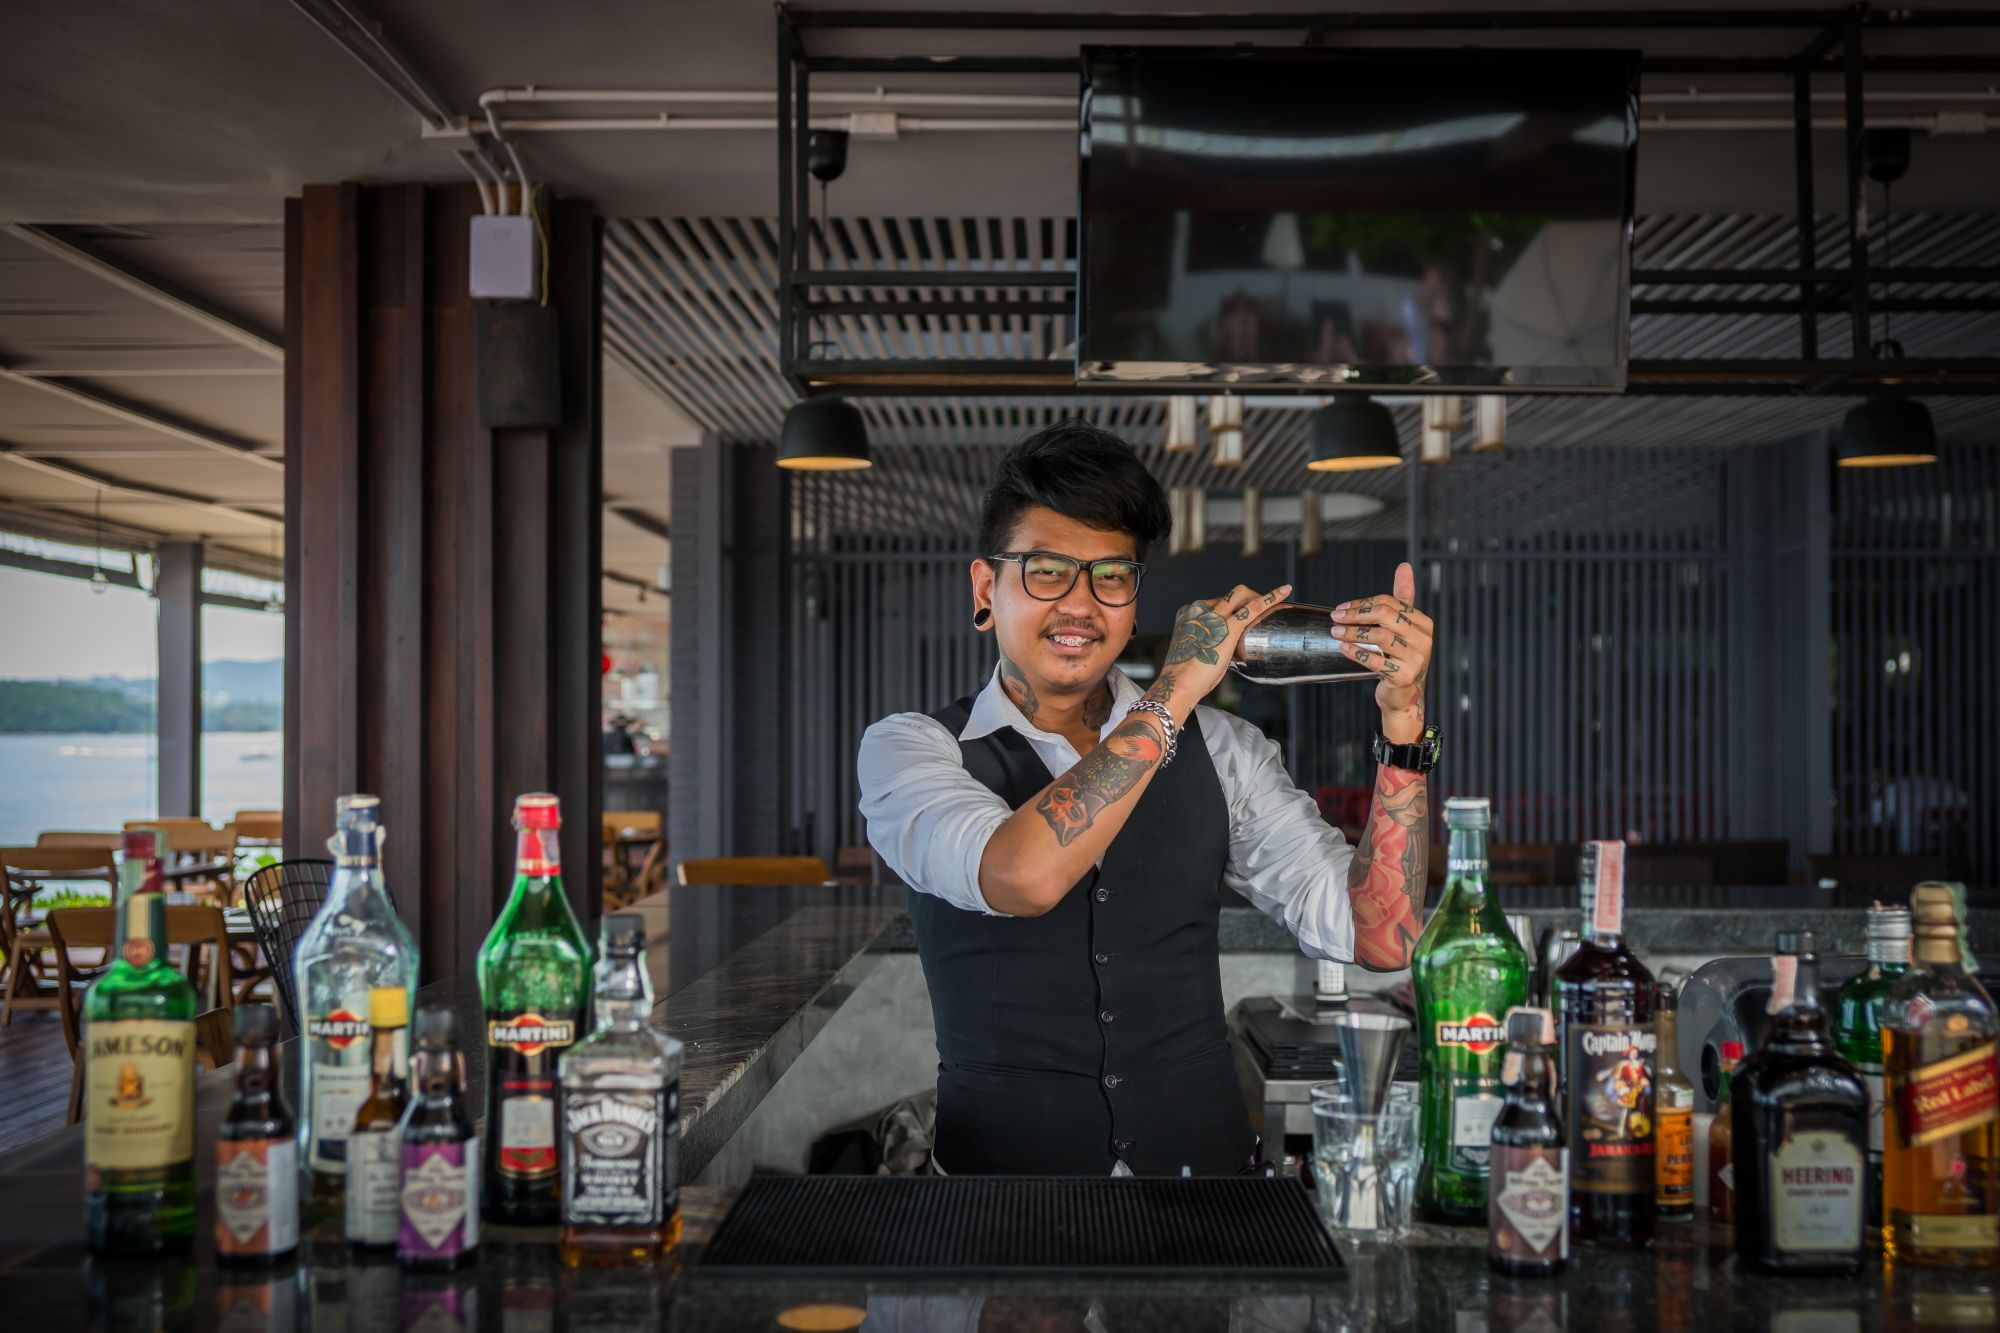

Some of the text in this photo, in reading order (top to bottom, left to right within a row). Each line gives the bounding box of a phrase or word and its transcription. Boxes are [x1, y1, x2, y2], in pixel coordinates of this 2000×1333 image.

[494, 1026, 568, 1041] MARTINI
[1582, 1031, 1629, 1056] Captain
[91, 1035, 187, 1058] JAMESON
[1913, 1089, 1951, 1113] Red
[1950, 1072, 1994, 1101] Label
[567, 1102, 602, 1133] JACK
[1781, 1166, 1855, 1185] HEERING
